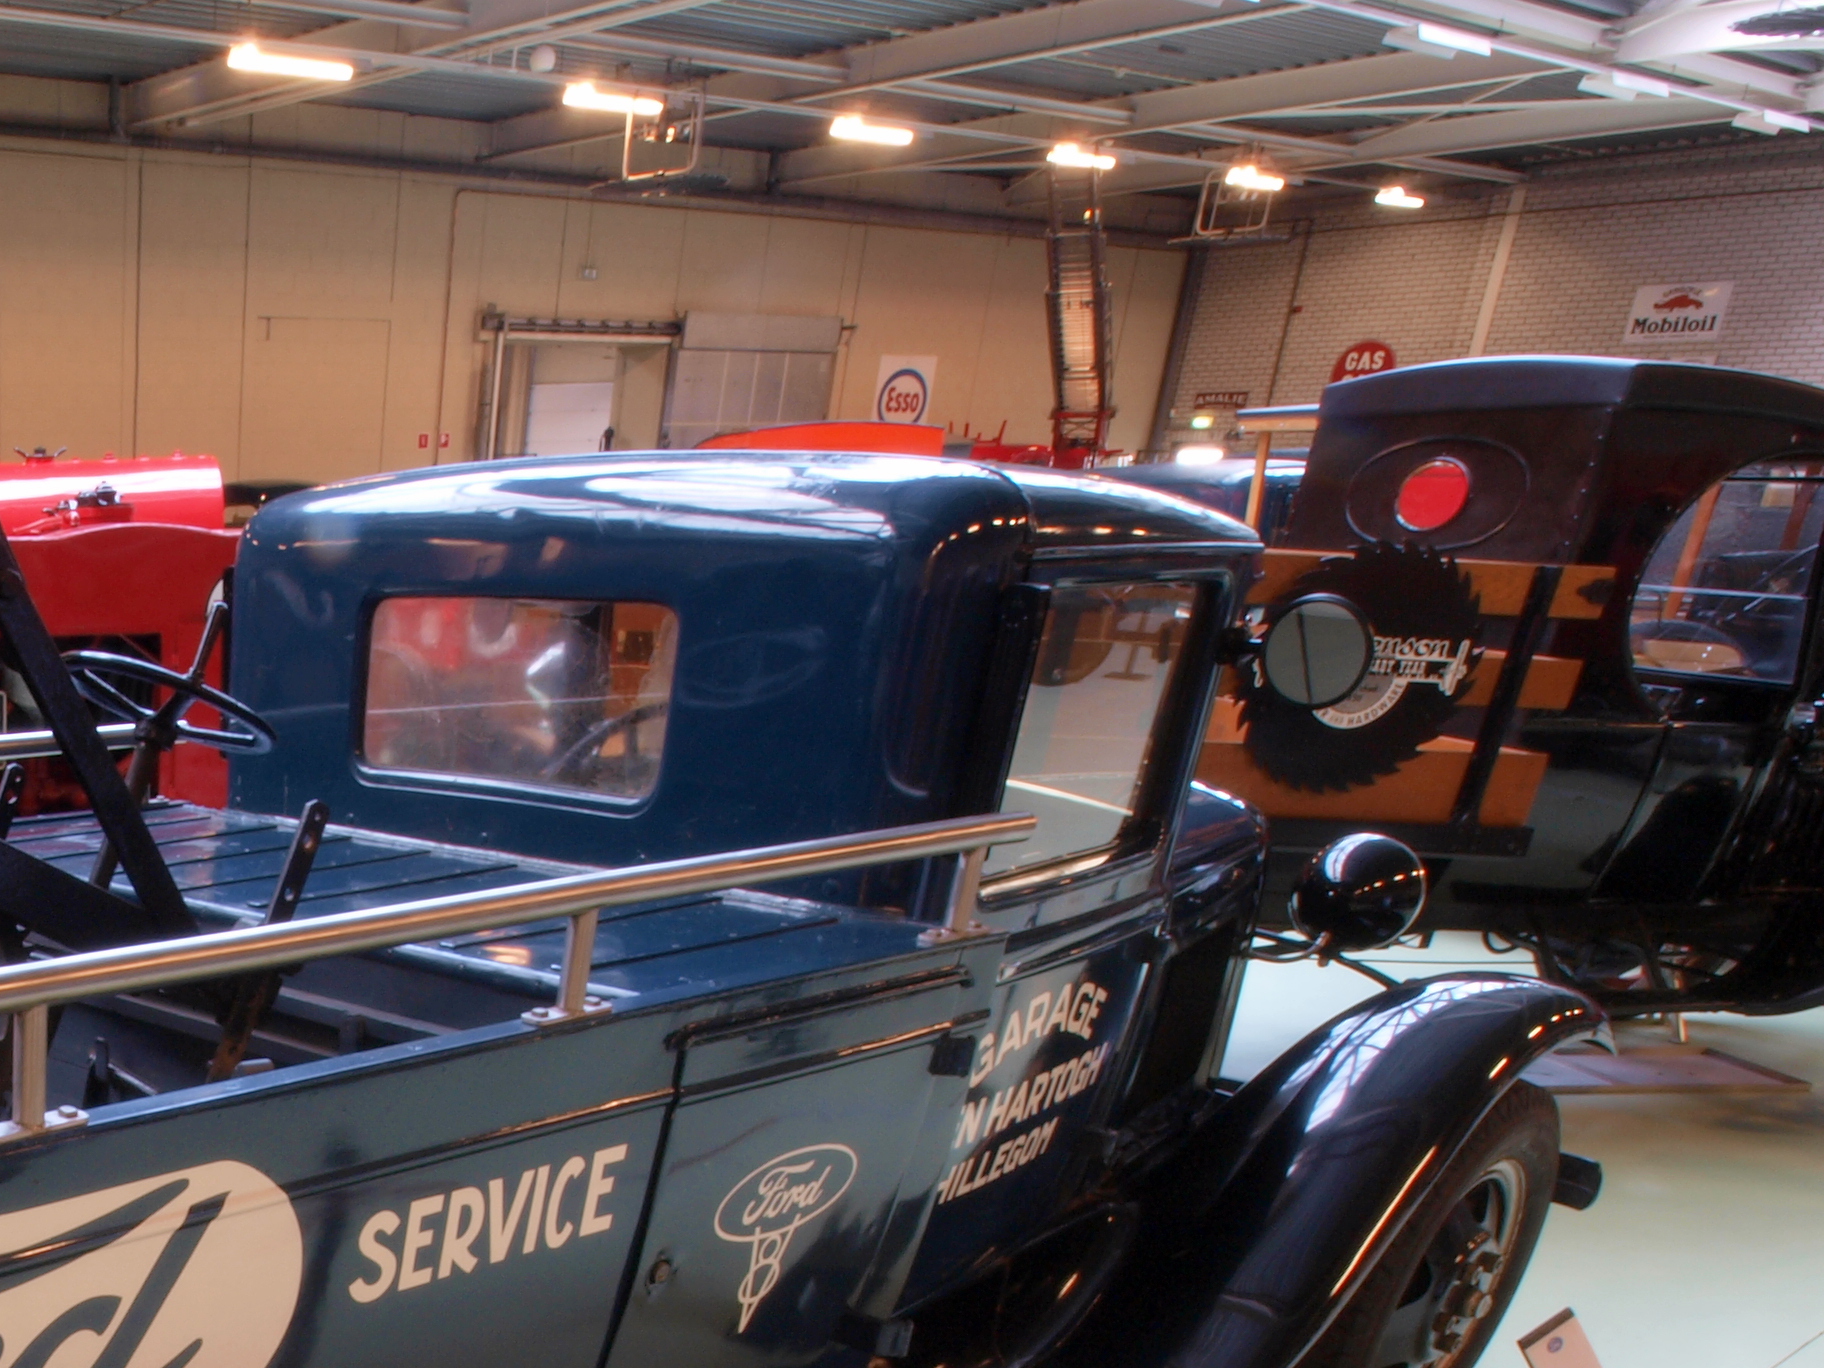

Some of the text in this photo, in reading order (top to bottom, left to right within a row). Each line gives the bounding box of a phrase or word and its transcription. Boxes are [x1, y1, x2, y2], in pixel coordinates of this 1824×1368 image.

[1631, 314, 1718, 335] Mobiloil
[1344, 350, 1387, 371] GAS
[885, 386, 920, 413] Esso
[969, 981, 1108, 1088] GARAGE
[983, 1041, 1110, 1138] HARTOGH
[348, 1143, 629, 1304] SERVICE
[742, 1160, 833, 1226] Ford
